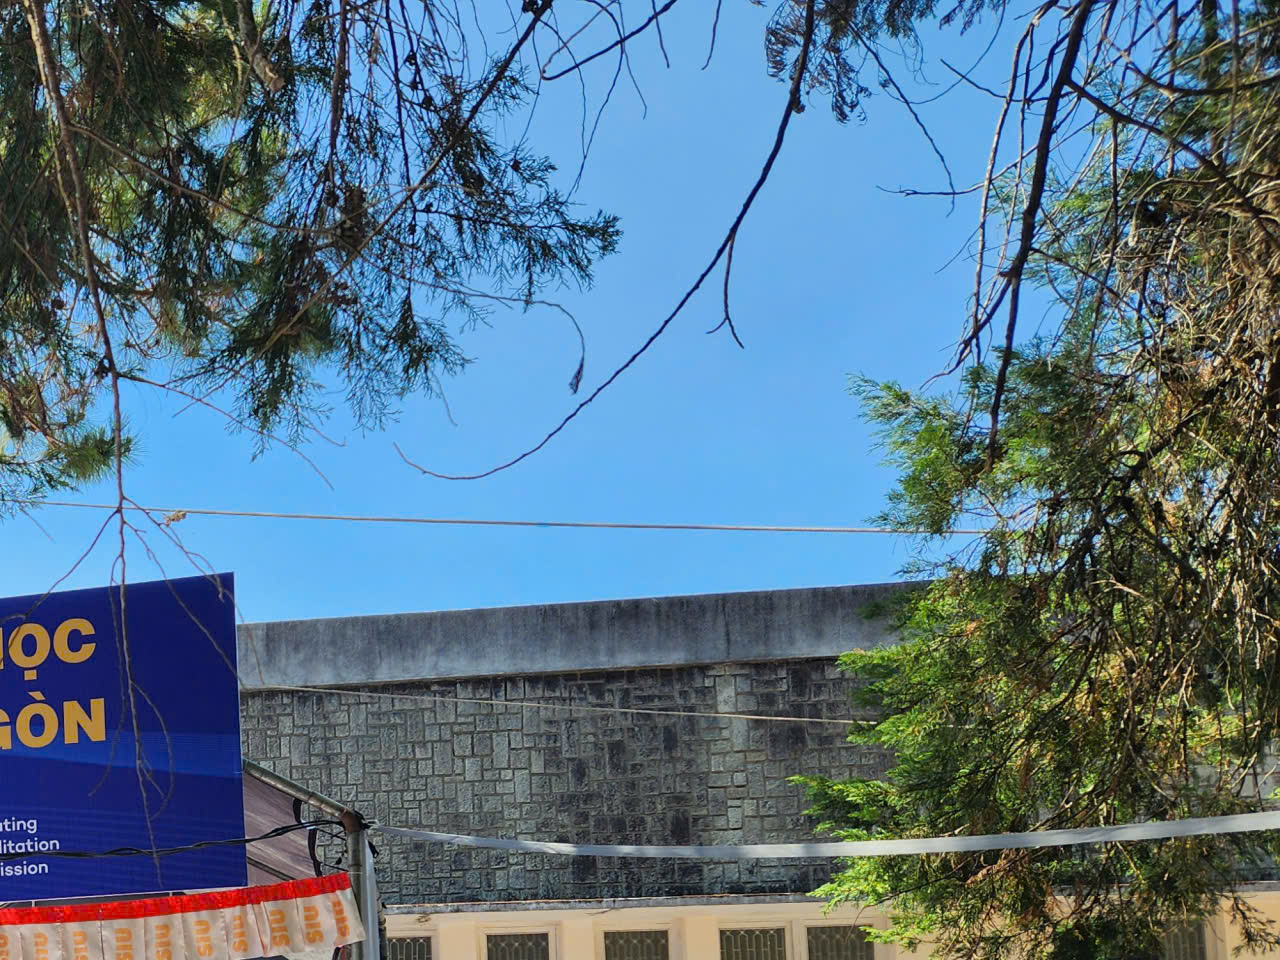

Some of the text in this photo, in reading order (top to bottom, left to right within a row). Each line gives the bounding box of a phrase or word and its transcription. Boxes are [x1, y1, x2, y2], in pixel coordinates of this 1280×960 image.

[155, 925, 173, 960] SIU
[194, 920, 214, 958] SIU
[270, 910, 291, 948] SIU
[304, 906, 325, 944] SIU
